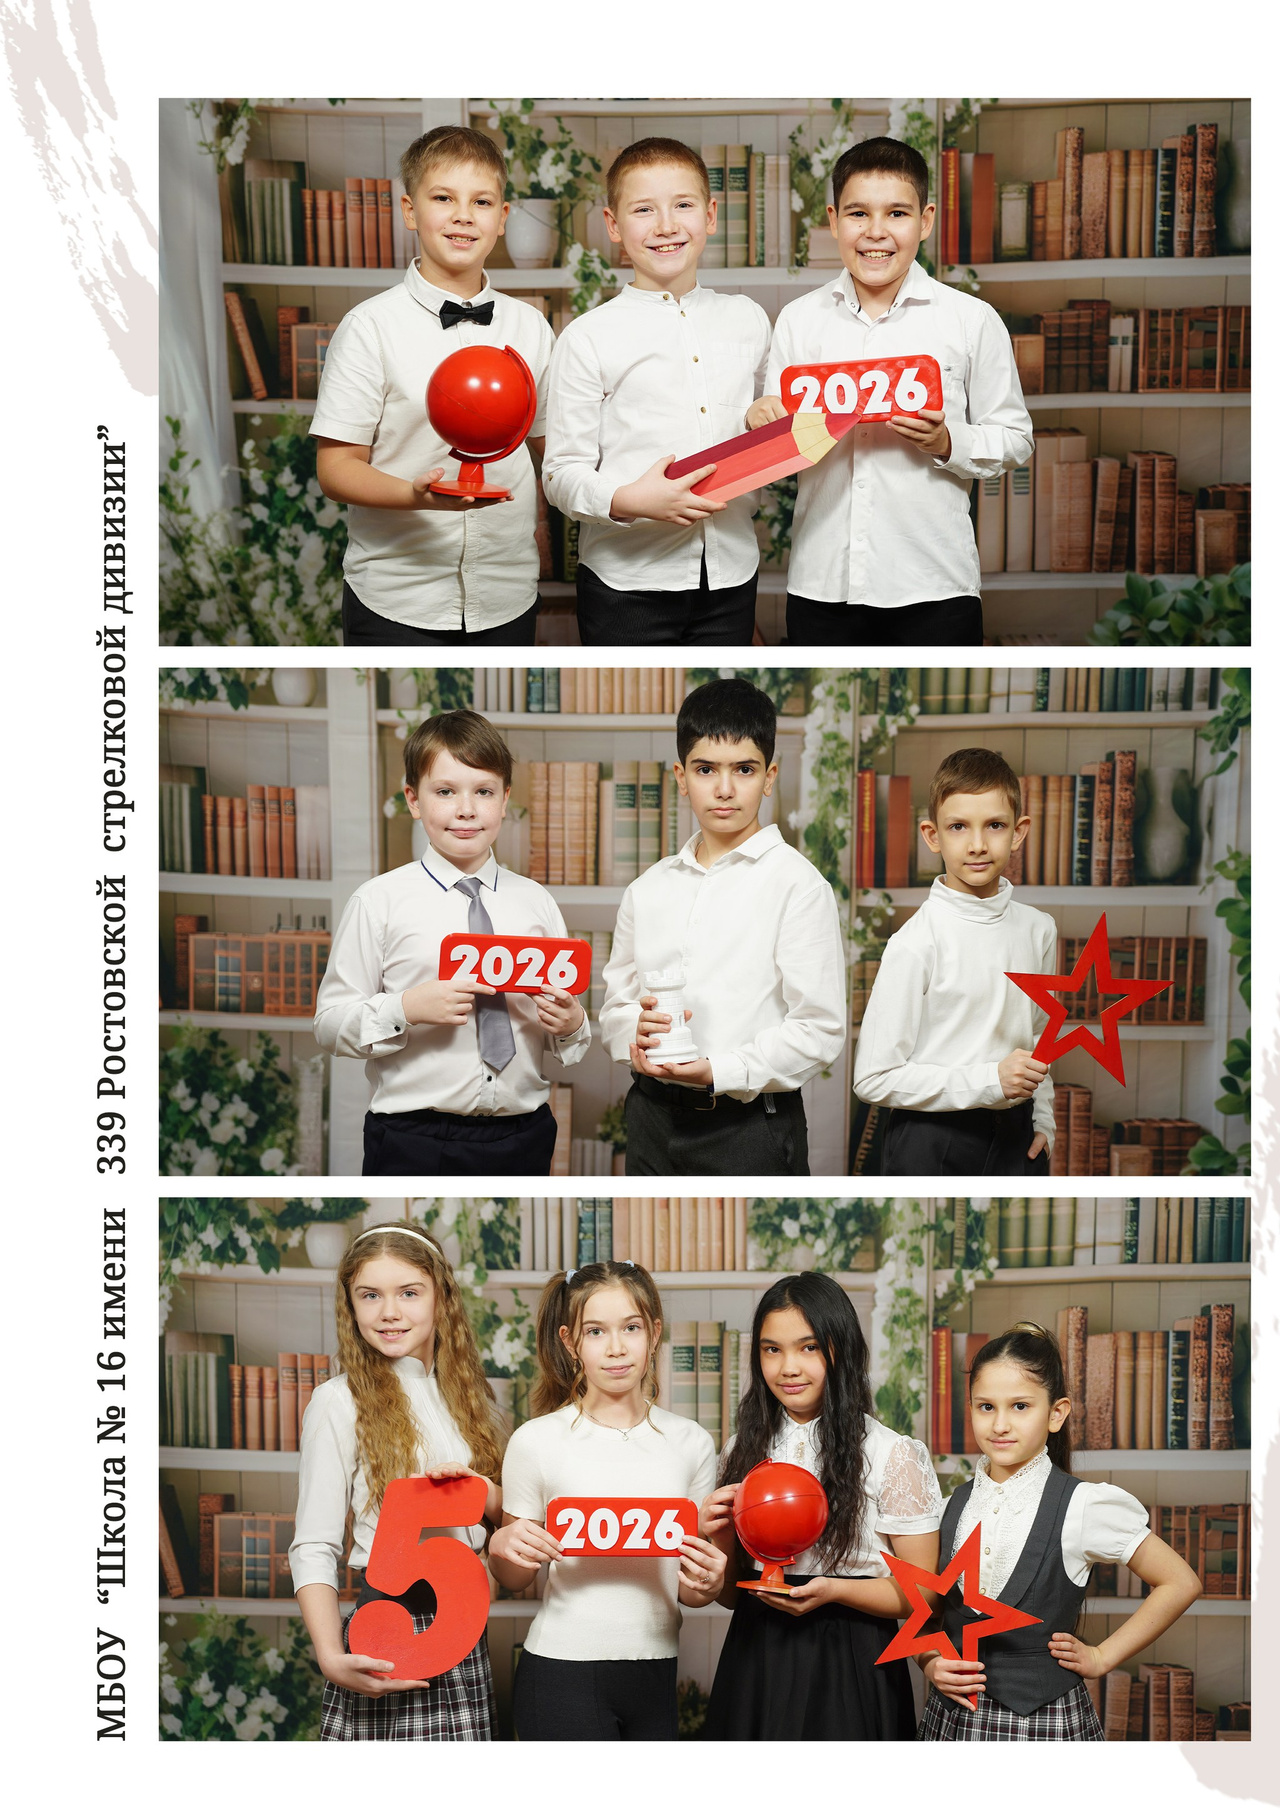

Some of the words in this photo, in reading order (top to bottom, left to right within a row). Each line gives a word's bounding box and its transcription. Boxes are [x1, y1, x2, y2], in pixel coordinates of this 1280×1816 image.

[790, 367, 929, 414] 2026
[449, 944, 578, 990] 2026
[556, 1507, 685, 1551] 2026
[348, 1475, 491, 1680] 5
